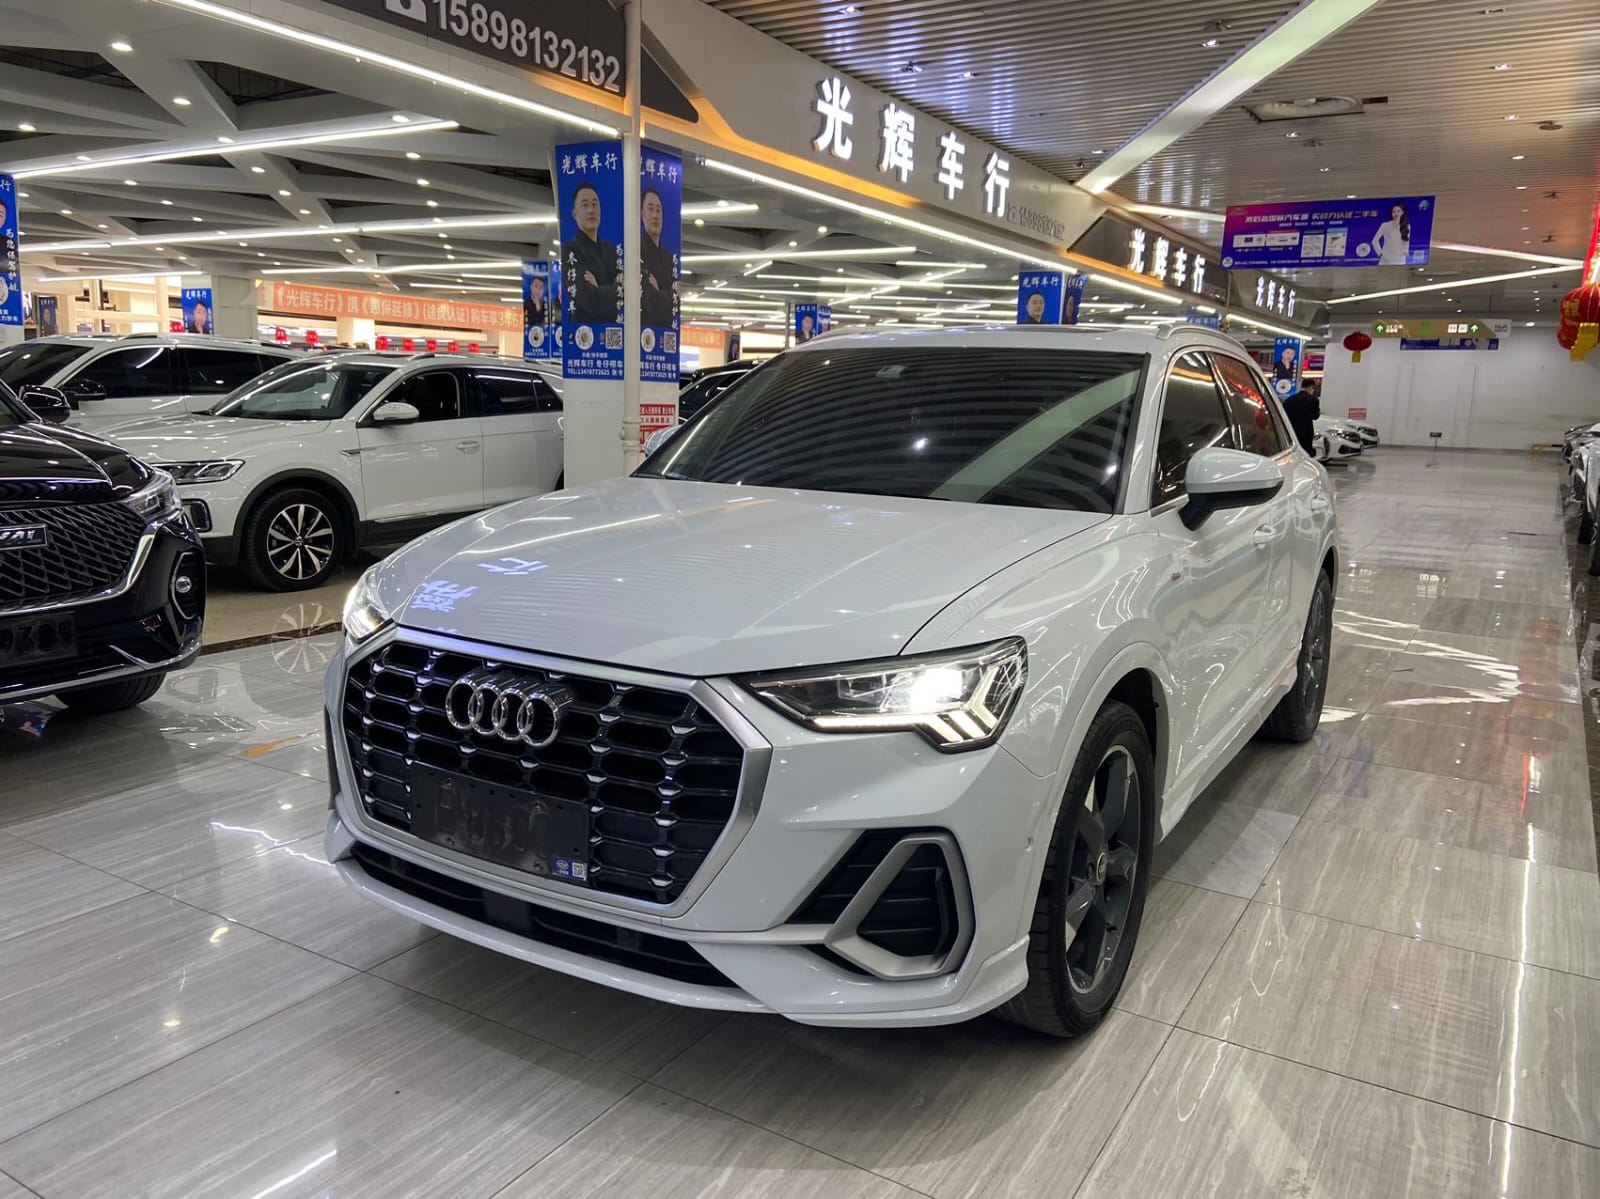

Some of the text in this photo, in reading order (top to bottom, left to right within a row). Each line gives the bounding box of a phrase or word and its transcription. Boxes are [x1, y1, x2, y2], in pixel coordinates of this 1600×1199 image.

[434, 0, 619, 92] 15898132132
[561, 152, 618, 175] 光辉车行
[814, 77, 1010, 218] 光辉车行
[1129, 228, 1206, 294] 光辉车行
